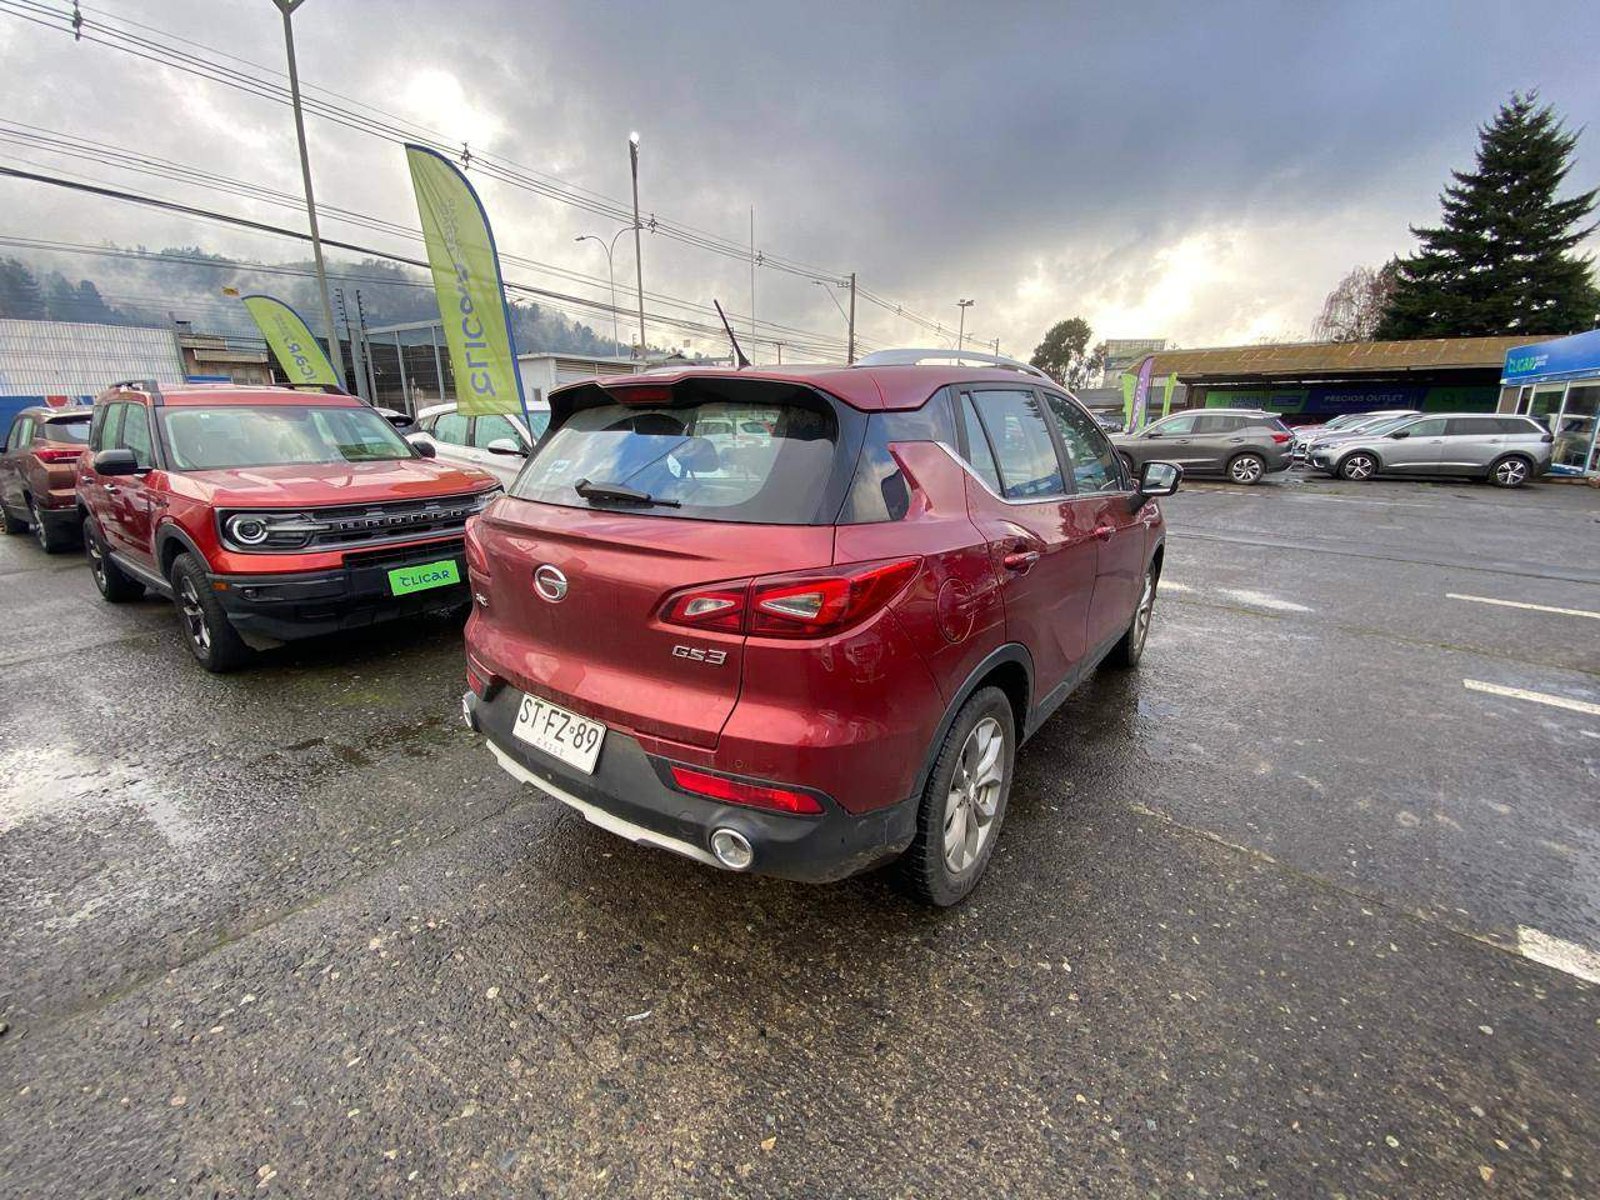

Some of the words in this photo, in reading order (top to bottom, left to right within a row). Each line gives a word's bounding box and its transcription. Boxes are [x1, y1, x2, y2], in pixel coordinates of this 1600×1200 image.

[1323, 393, 1363, 403] PRECIOS
[1365, 392, 1404, 402] OUTLET
[672, 645, 727, 665] GS3
